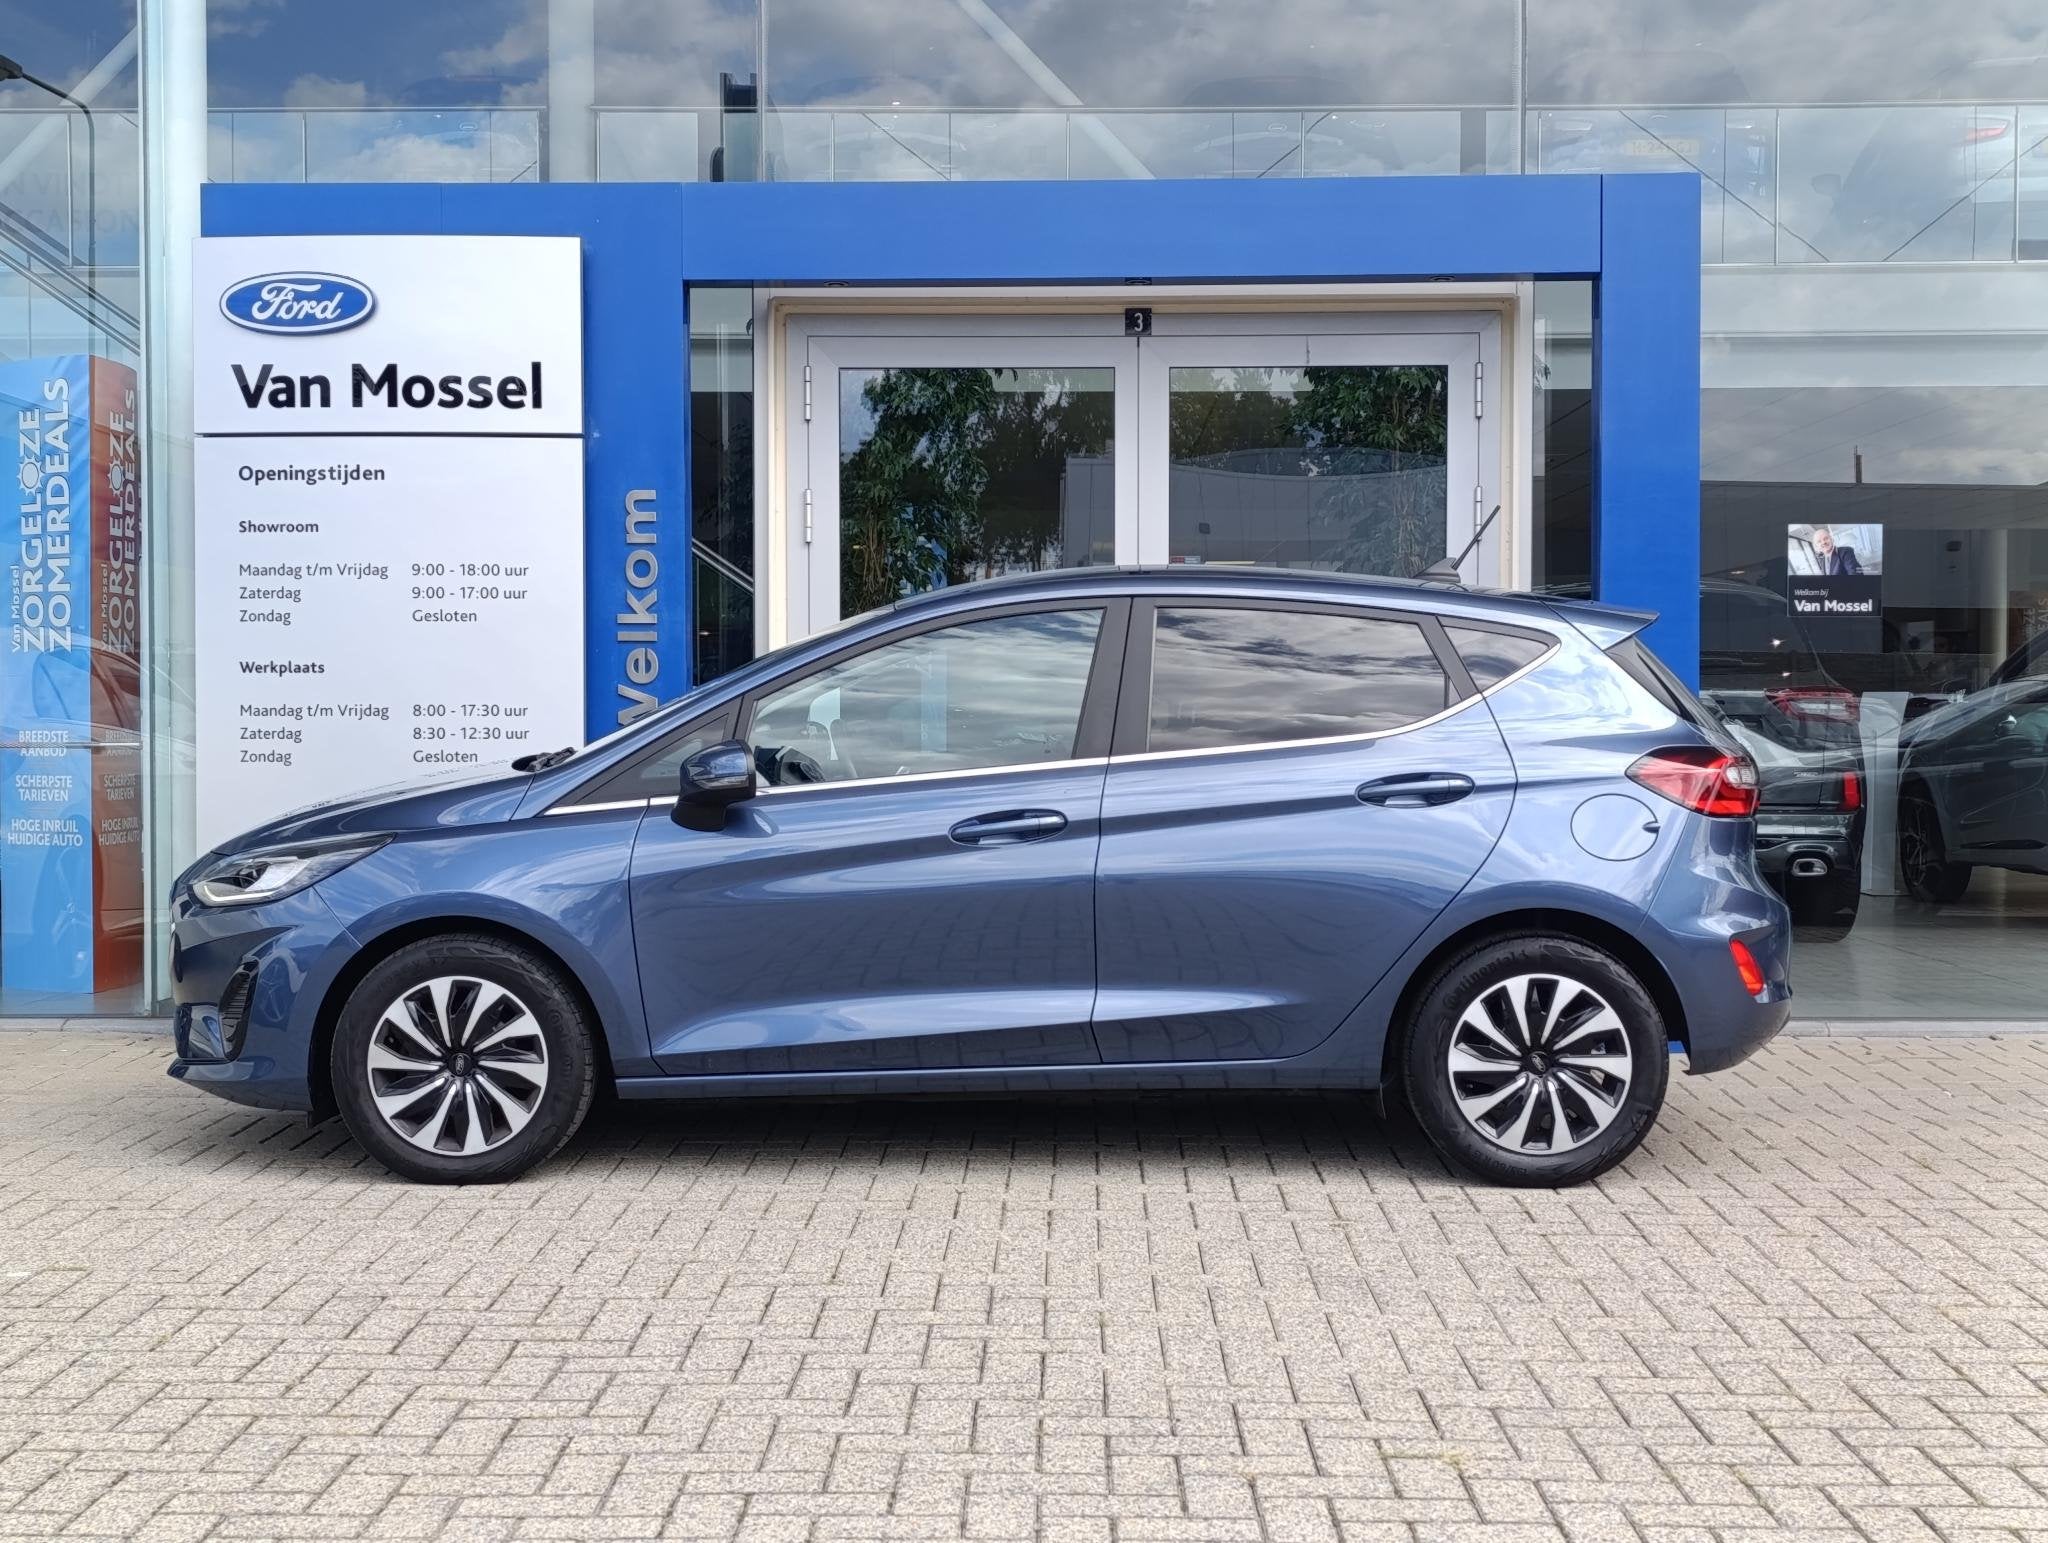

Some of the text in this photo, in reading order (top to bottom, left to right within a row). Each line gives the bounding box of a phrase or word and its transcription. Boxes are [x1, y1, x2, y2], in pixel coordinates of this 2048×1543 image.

[251, 281, 344, 321] Ford
[1133, 312, 1144, 332] 3
[230, 361, 543, 410] Van Mossel
[238, 463, 386, 487] Openingstijden
[44, 377, 72, 653] ZOMERDEALS
[238, 519, 319, 534] Showroom
[239, 562, 302, 581] Maandag
[305, 562, 333, 578] t/m
[336, 562, 389, 580] Vrijdag
[411, 563, 445, 577] 9:00
[459, 563, 501, 577] 18:00
[504, 566, 530, 577] uur
[239, 585, 302, 604] Zaterdag
[411, 586, 446, 600] 9:00
[459, 586, 500, 600] 17:00
[503, 589, 528, 600] uur
[10, 564, 21, 652] Van Mossel
[1793, 598, 1873, 612] Van Mossel
[239, 608, 478, 627] Zondag Gesloten
[239, 659, 326, 678] Werkplaats
[239, 703, 303, 721] Maandag
[306, 703, 334, 718] t/m
[337, 703, 390, 721] Vrijdag
[412, 703, 447, 717] 8:00
[460, 703, 500, 717] 17:30
[504, 707, 529, 717] uur
[19, 730, 69, 742] BREEDSTE
[239, 726, 303, 744] Zaterdag
[412, 726, 446, 740] 8:30
[460, 726, 502, 740] 12:30
[505, 730, 530, 740] uur
[239, 749, 478, 767] Zondag Gesloten
[15, 774, 73, 788] SCHERPSTE
[19, 789, 69, 802] TARIEVEN
[11, 818, 78, 832] HOGE INRUIL
[8, 833, 83, 847] HUIDIGE AUTO
